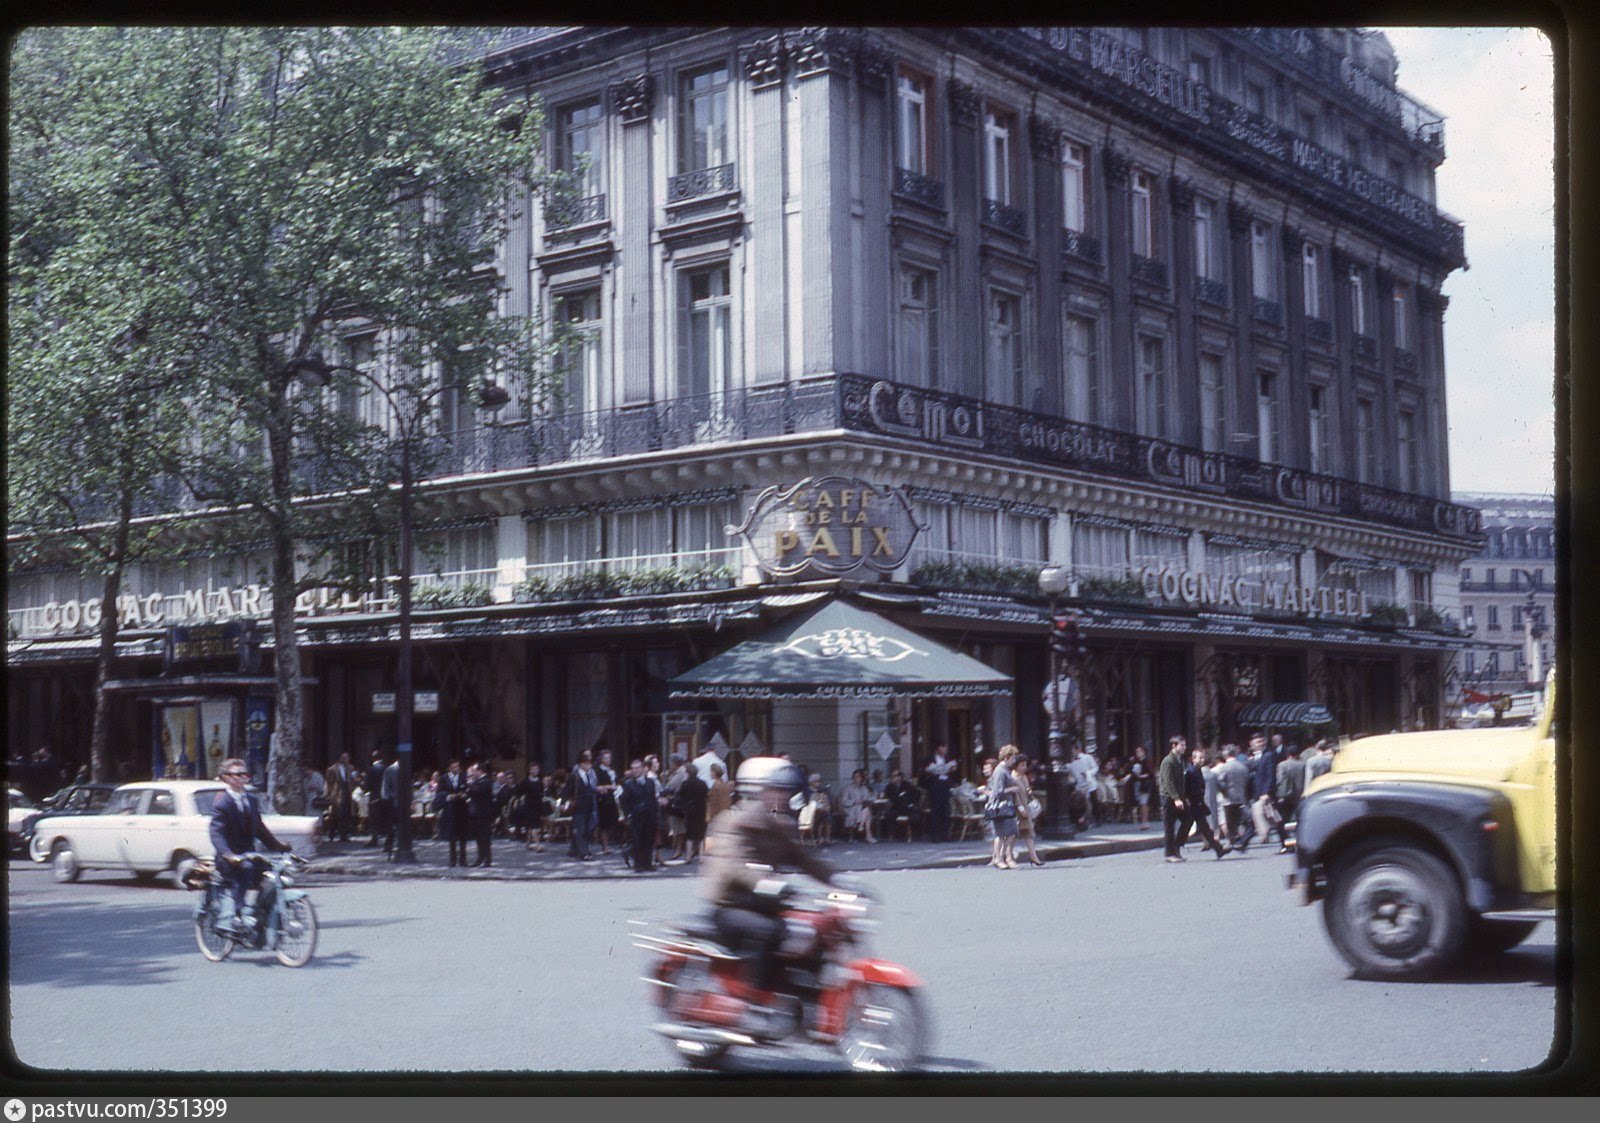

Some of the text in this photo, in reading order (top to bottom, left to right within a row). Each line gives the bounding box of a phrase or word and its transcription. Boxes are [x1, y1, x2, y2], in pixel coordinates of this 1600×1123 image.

[805, 510, 869, 525] DE LA
[775, 526, 894, 559] PAIX
[43, 584, 366, 630] COGAC MARELL
[1141, 565, 1372, 618] COGNAC MARTELL
